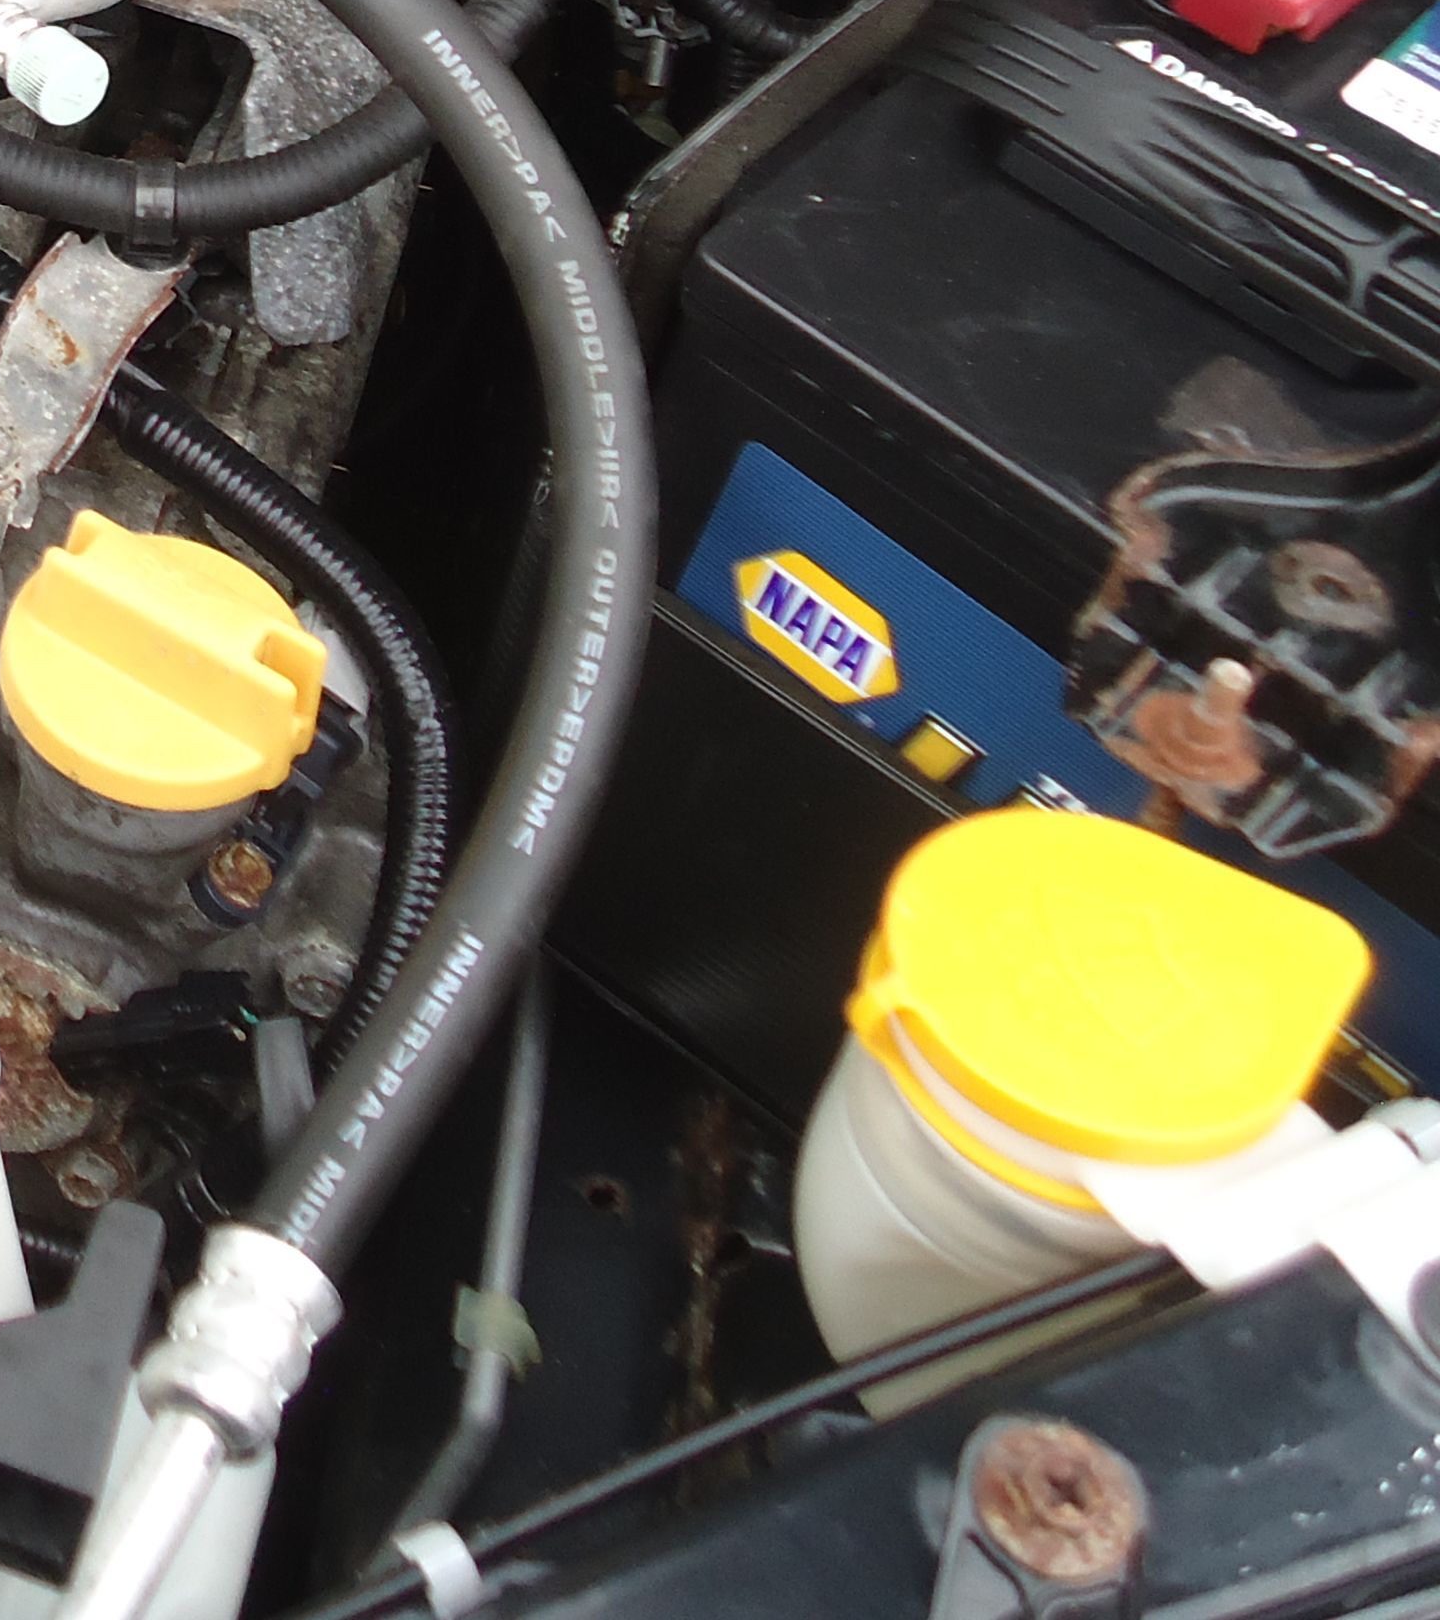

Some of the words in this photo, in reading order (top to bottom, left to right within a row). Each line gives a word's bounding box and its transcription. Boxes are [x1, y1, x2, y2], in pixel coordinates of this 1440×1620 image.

[422, 28, 567, 243] INNER>PA<
[557, 258, 622, 529] MIDDLE>IIR<
[509, 548, 618, 857] OUTER>EPDM<
[755, 569, 873, 687] NAPA
[338, 932, 485, 1150] INNER>PA<
